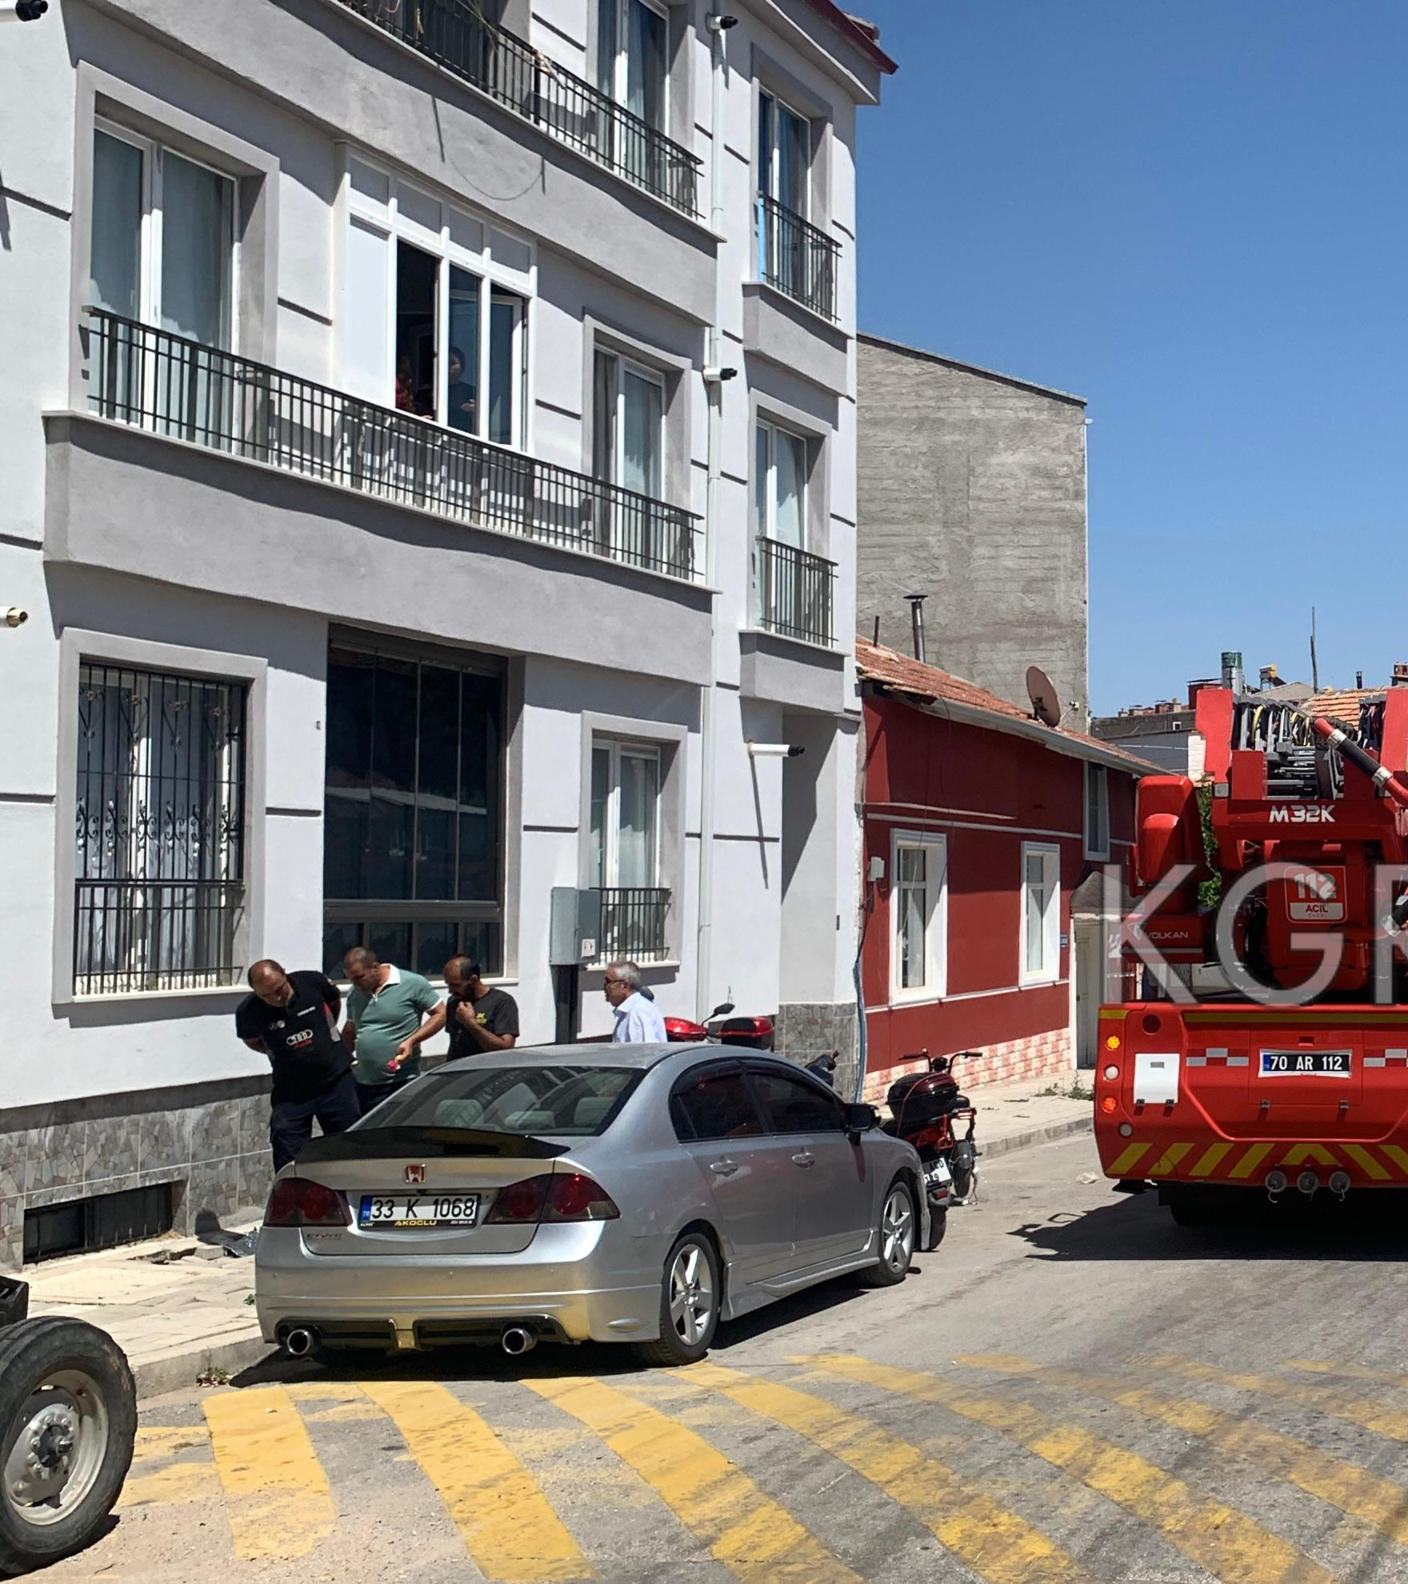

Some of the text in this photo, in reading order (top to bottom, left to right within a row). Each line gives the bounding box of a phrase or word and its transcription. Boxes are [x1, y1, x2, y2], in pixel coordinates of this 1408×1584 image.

[1269, 804, 1336, 823] M32K
[1294, 873, 1337, 899] 112
[1270, 1056, 1343, 1070] 70 AR 112
[372, 1198, 475, 1219] 33 K 1068
